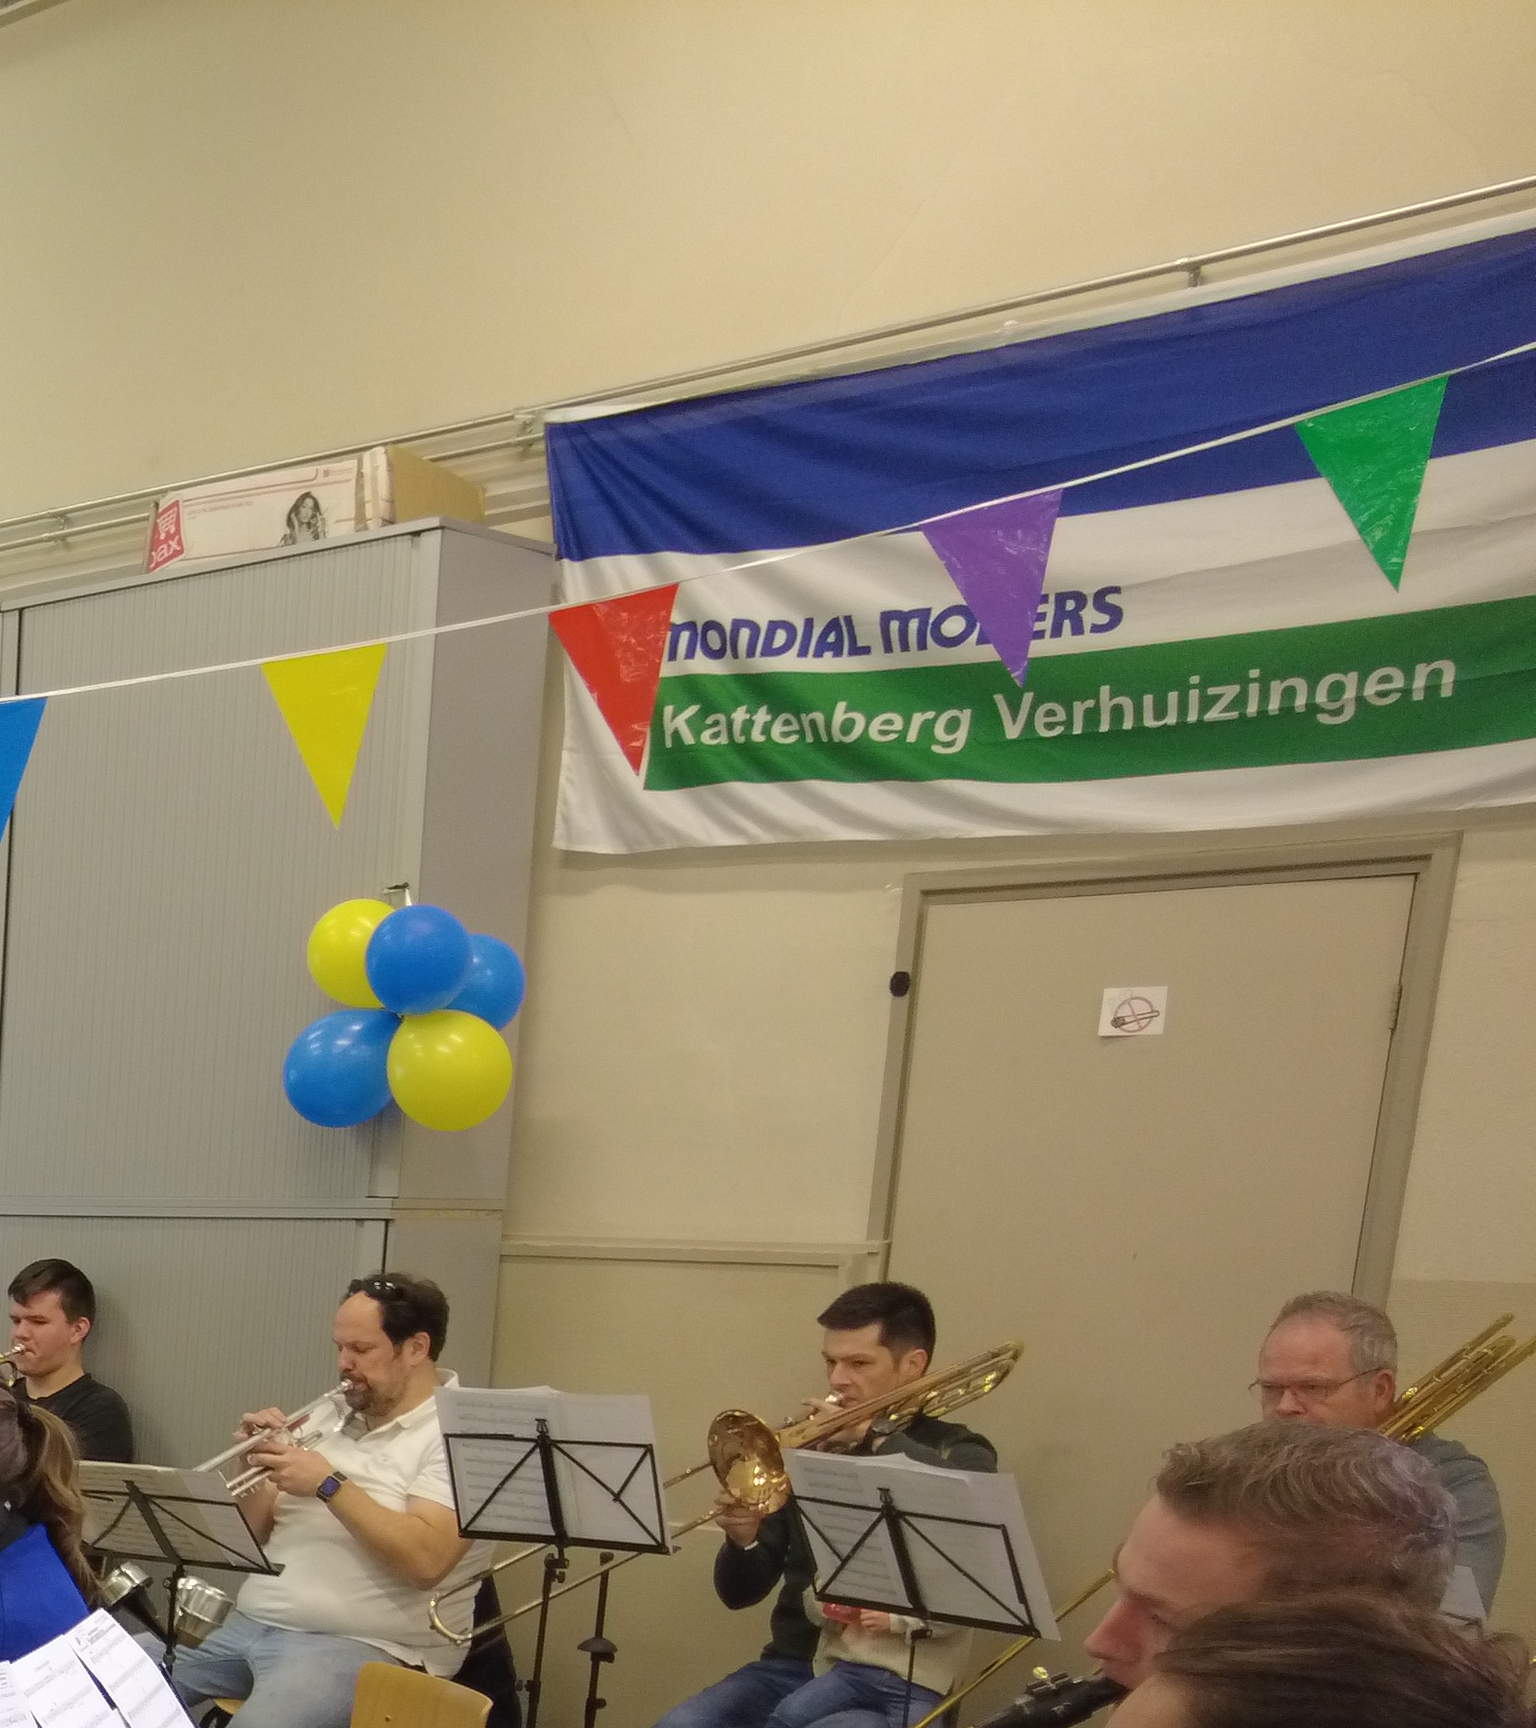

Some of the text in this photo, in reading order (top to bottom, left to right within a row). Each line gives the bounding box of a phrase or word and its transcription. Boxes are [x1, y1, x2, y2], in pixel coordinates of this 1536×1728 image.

[880, 586, 1126, 655] MOERS
[662, 659, 1457, 756] Kattenberg Verhuizingen
